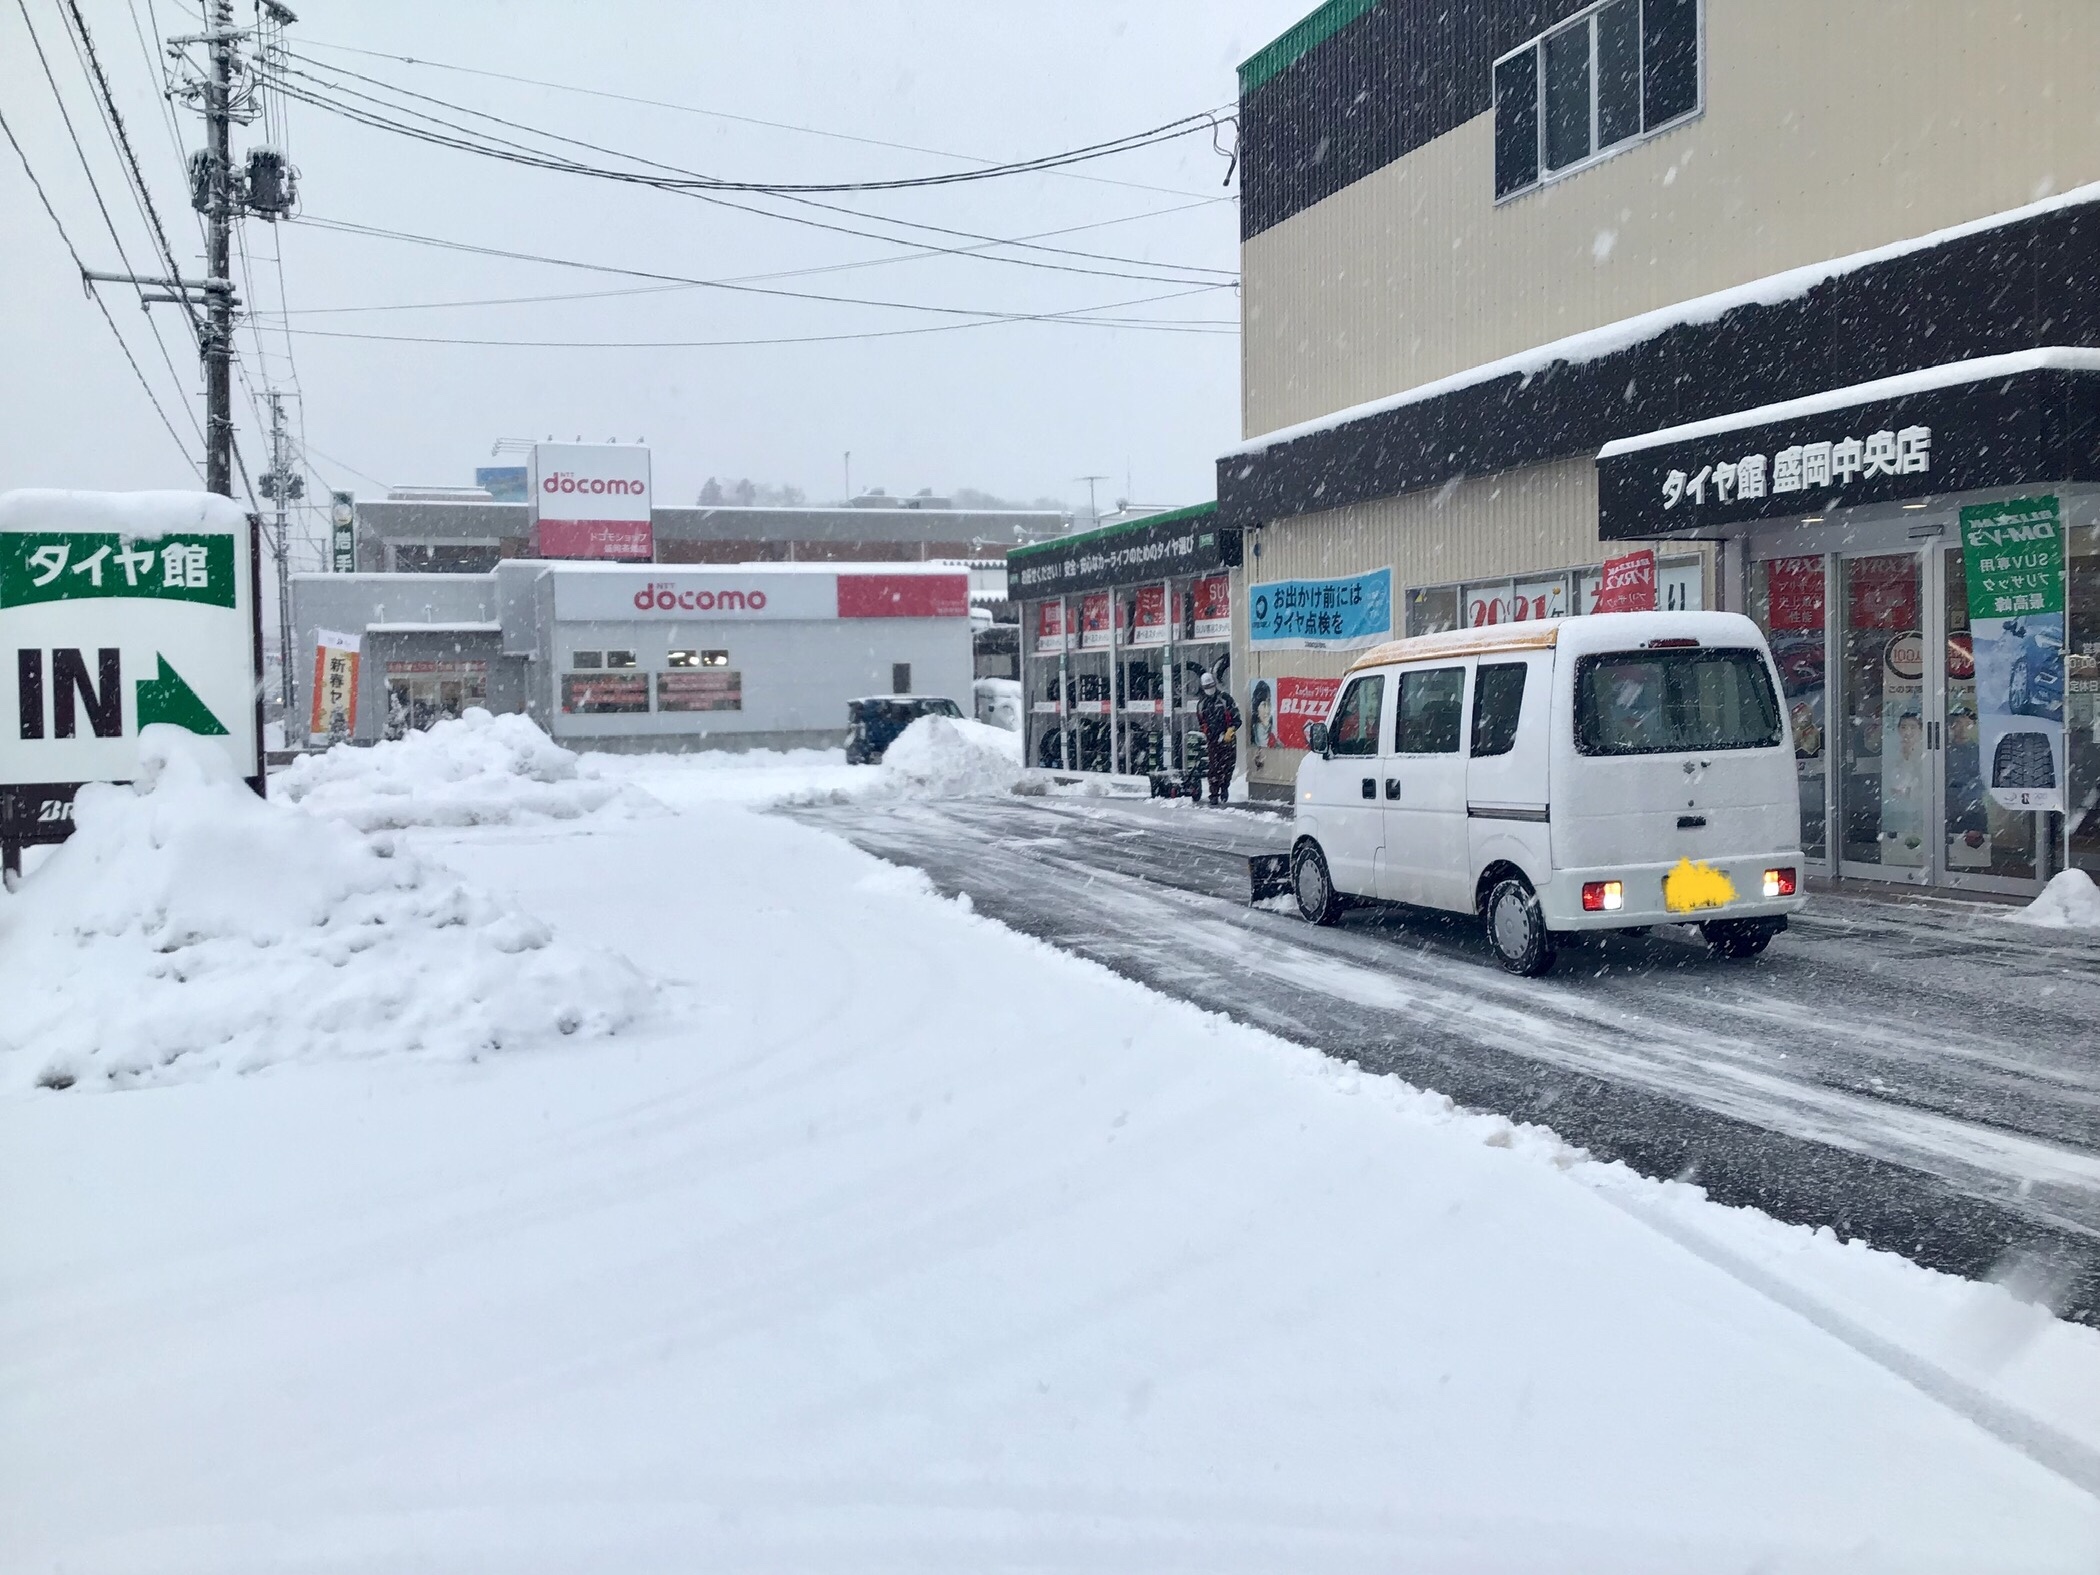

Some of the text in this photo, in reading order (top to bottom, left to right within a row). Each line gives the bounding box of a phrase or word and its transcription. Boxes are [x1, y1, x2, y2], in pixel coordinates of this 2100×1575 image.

[1661, 425, 1932, 511] タイヤ館 盛岡中央店
[543, 472, 645, 495] docomo
[29, 542, 208, 588] タイヤ館
[634, 583, 766, 610] docomo
[1273, 582, 1362, 609] お出かけ前には
[1273, 611, 1344, 635] タイヤ点検を
[17, 648, 123, 739] IN
